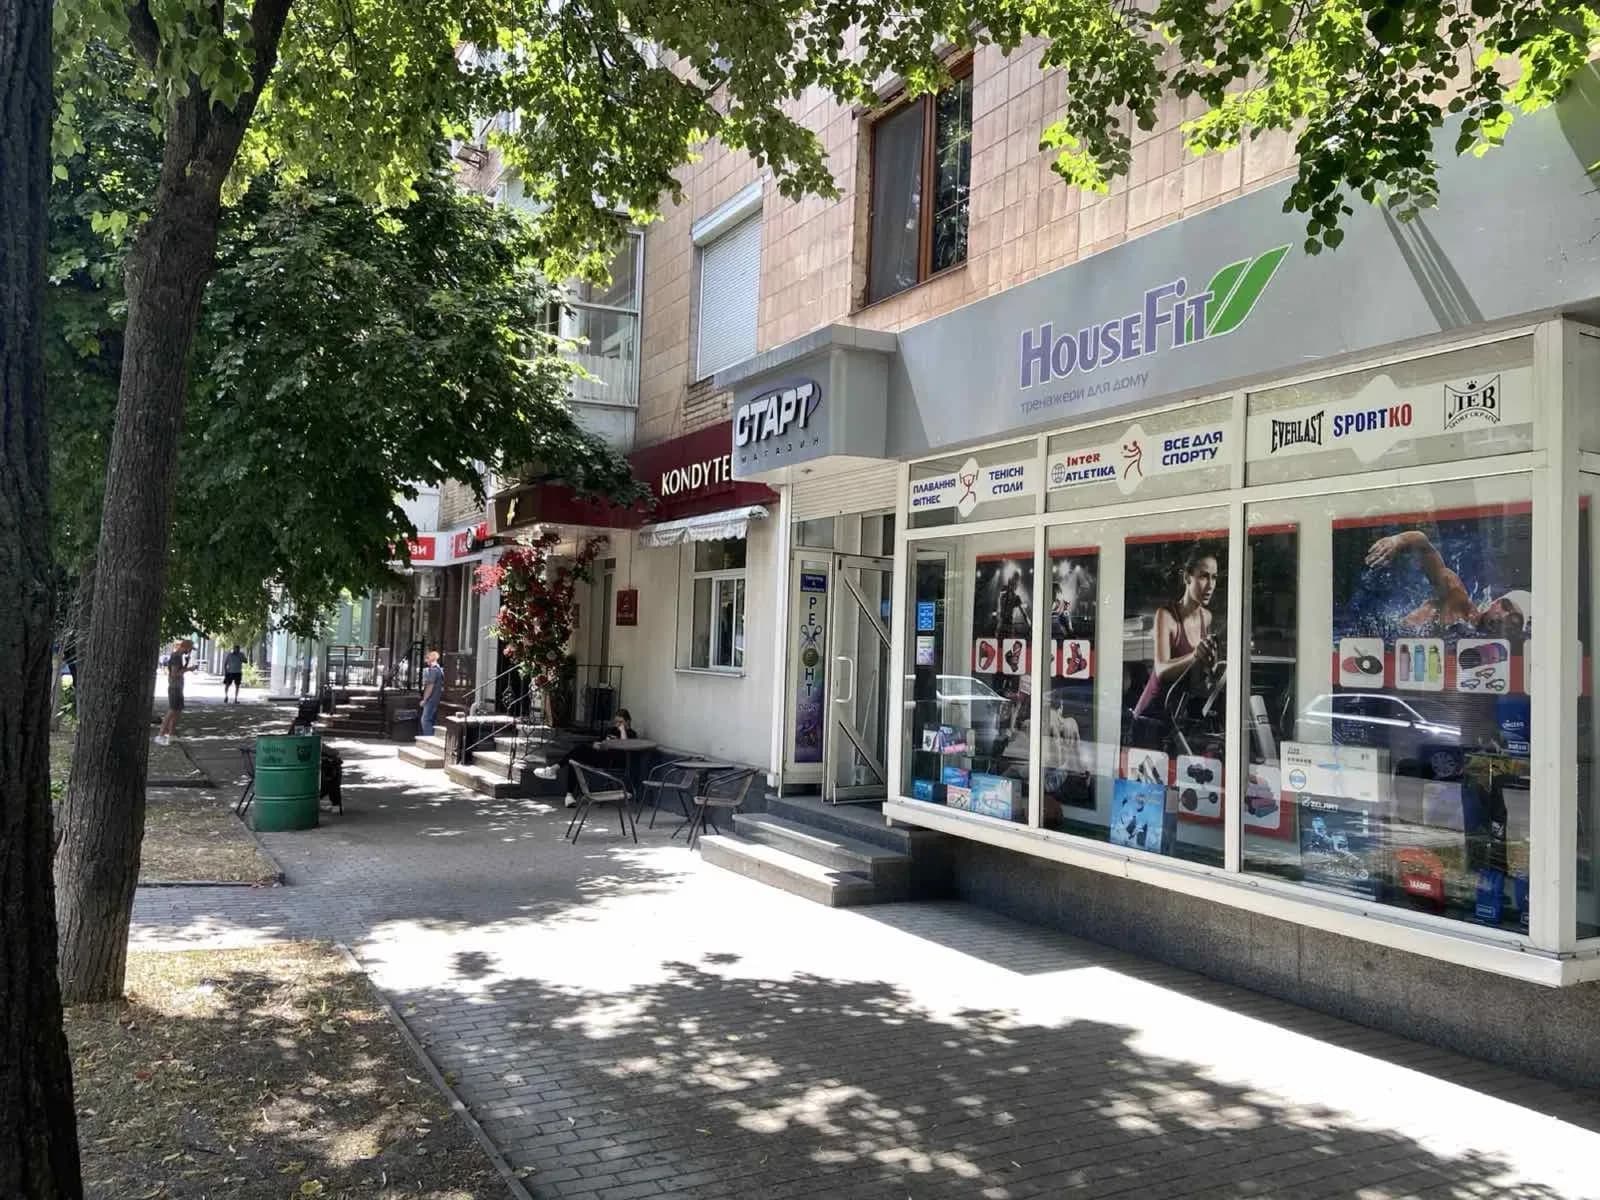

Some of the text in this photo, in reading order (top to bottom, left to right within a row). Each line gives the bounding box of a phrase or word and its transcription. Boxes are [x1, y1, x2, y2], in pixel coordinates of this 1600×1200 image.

[1087, 380, 1111, 398] для
[1113, 371, 1149, 392] дому
[735, 383, 813, 447] СТАРТ
[1164, 431, 1223, 451] ВСЕ ДЛЯ
[1271, 411, 1324, 453] EVERLAST
[1162, 447, 1219, 466] СПОРТУ
[988, 466, 1024, 481] ТЕНІСНІ
[1065, 465, 1116, 482] ATLETIKA
[913, 478, 956, 495] ПЛАВАННЯ
[992, 481, 1024, 495] СТОЛИ
[912, 494, 941, 506] ФІТНЕС
